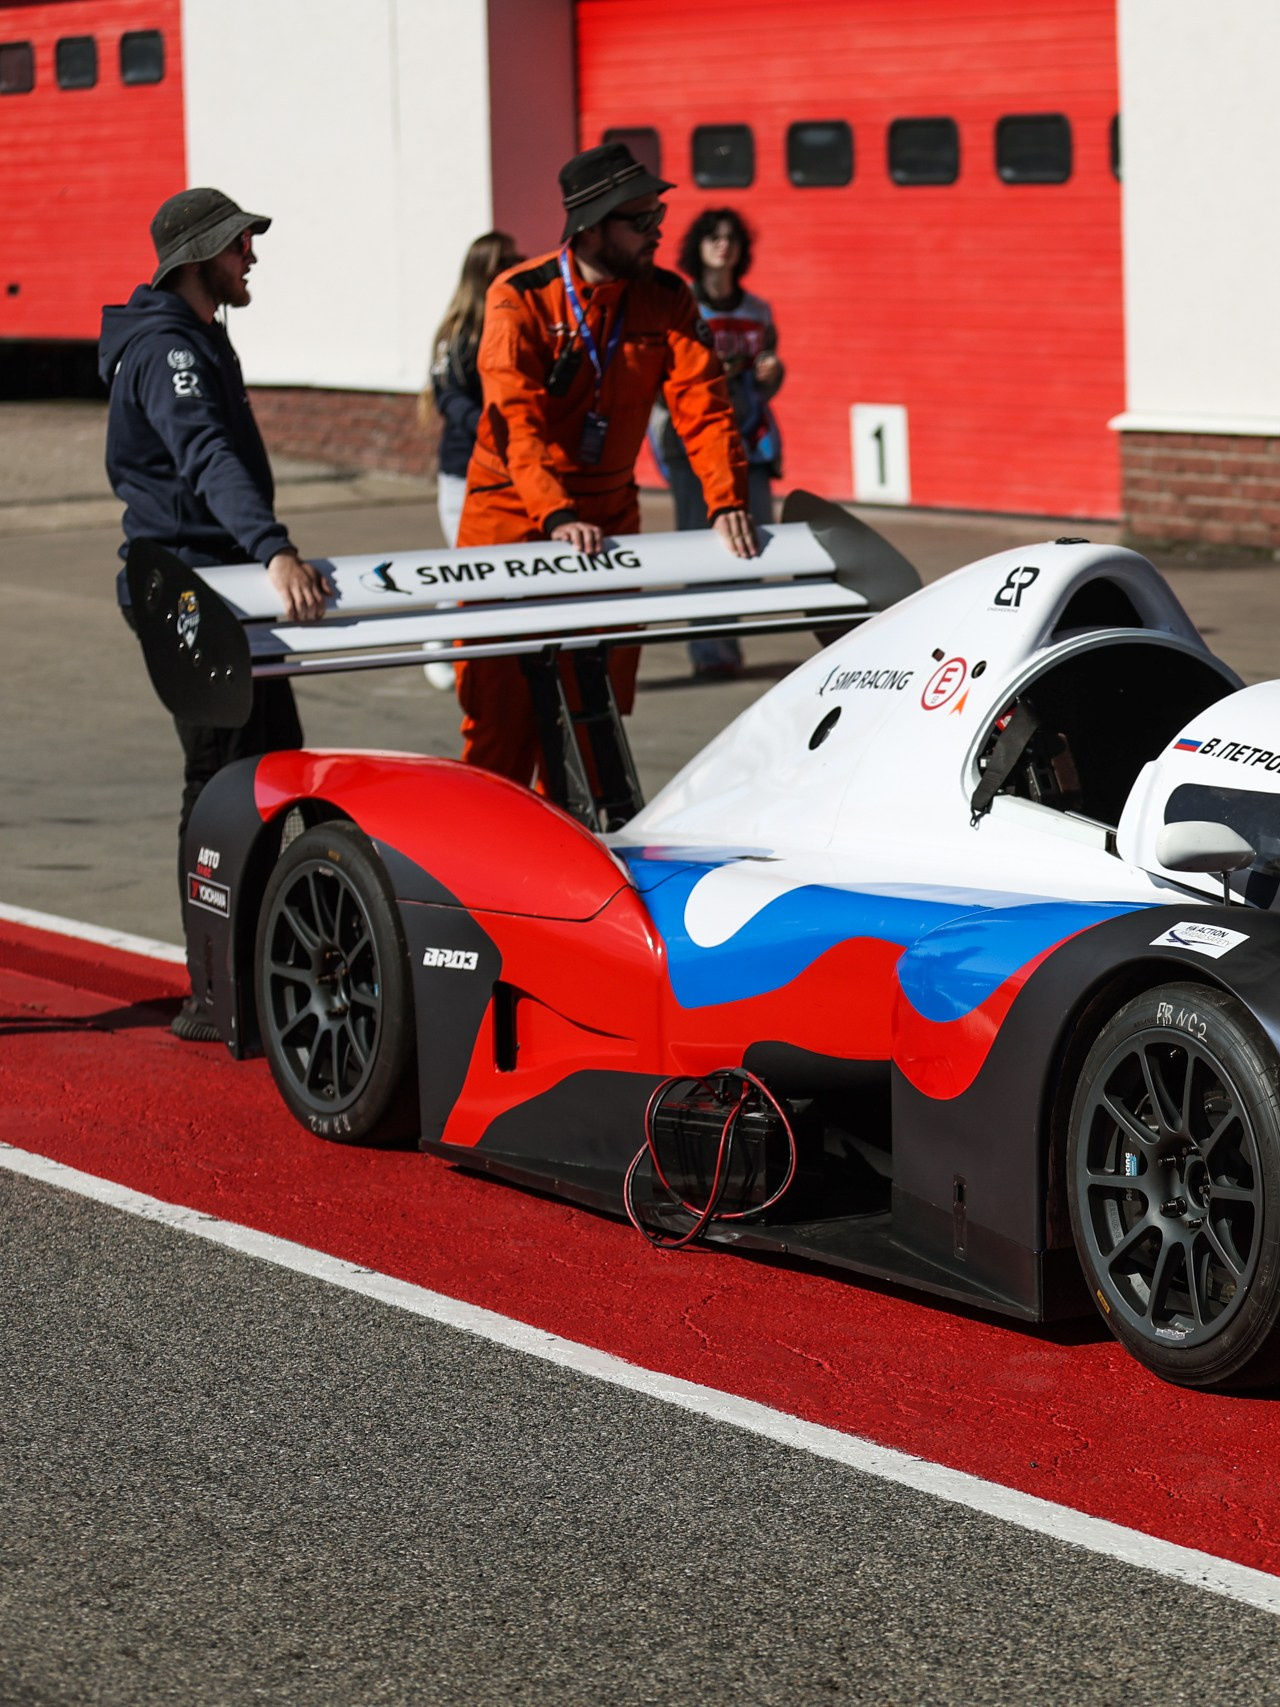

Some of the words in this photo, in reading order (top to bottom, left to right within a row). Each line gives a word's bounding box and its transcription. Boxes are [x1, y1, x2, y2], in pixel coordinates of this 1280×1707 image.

[872, 423, 886, 487] 1
[416, 562, 495, 585] SMP
[504, 550, 642, 578] RACING
[830, 671, 862, 691] SMP
[855, 670, 914, 690] RACING
[933, 667, 959, 694] E
[1197, 927, 1229, 938] ACTION
